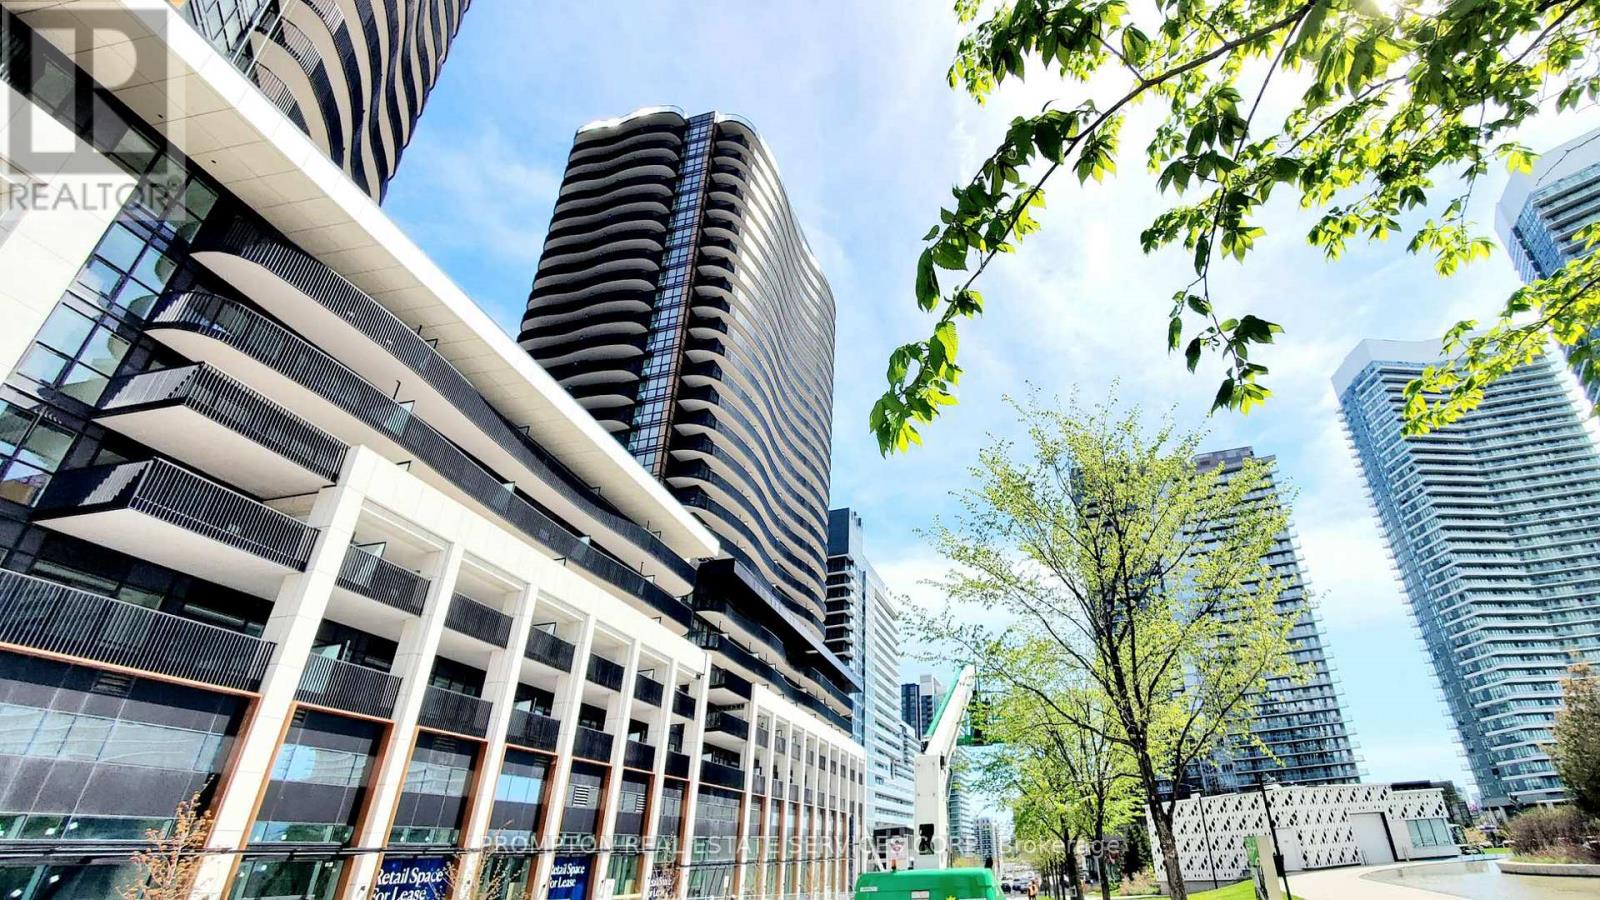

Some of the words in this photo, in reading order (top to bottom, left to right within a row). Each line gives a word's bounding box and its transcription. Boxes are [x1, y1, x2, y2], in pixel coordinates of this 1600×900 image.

[377, 867, 409, 885] Retail
[409, 867, 444, 887] Space
[567, 863, 585, 877] Space
[558, 876, 576, 888] Lease
[391, 886, 427, 900] Lease
